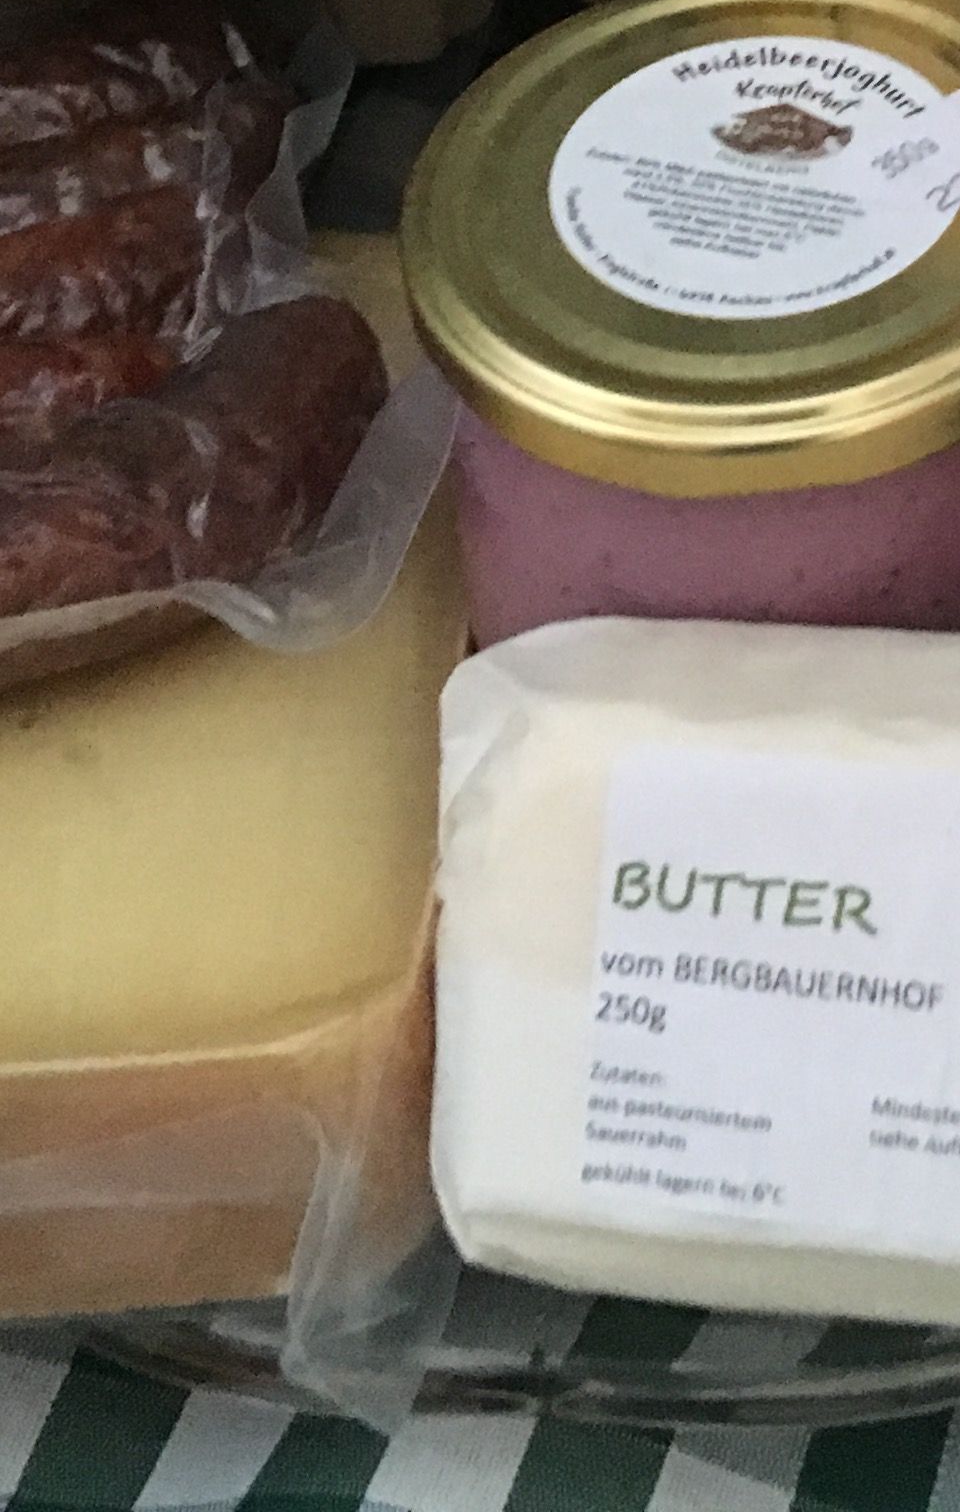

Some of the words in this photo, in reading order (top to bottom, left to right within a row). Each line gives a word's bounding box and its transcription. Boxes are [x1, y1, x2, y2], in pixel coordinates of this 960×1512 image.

[671, 46, 926, 120] Heidelbeerjoghurt
[612, 859, 877, 936] BUTTER
[595, 990, 667, 1035] 250g
[600, 950, 664, 979] vom
[673, 952, 945, 1012] BERGBAUERNHOF
